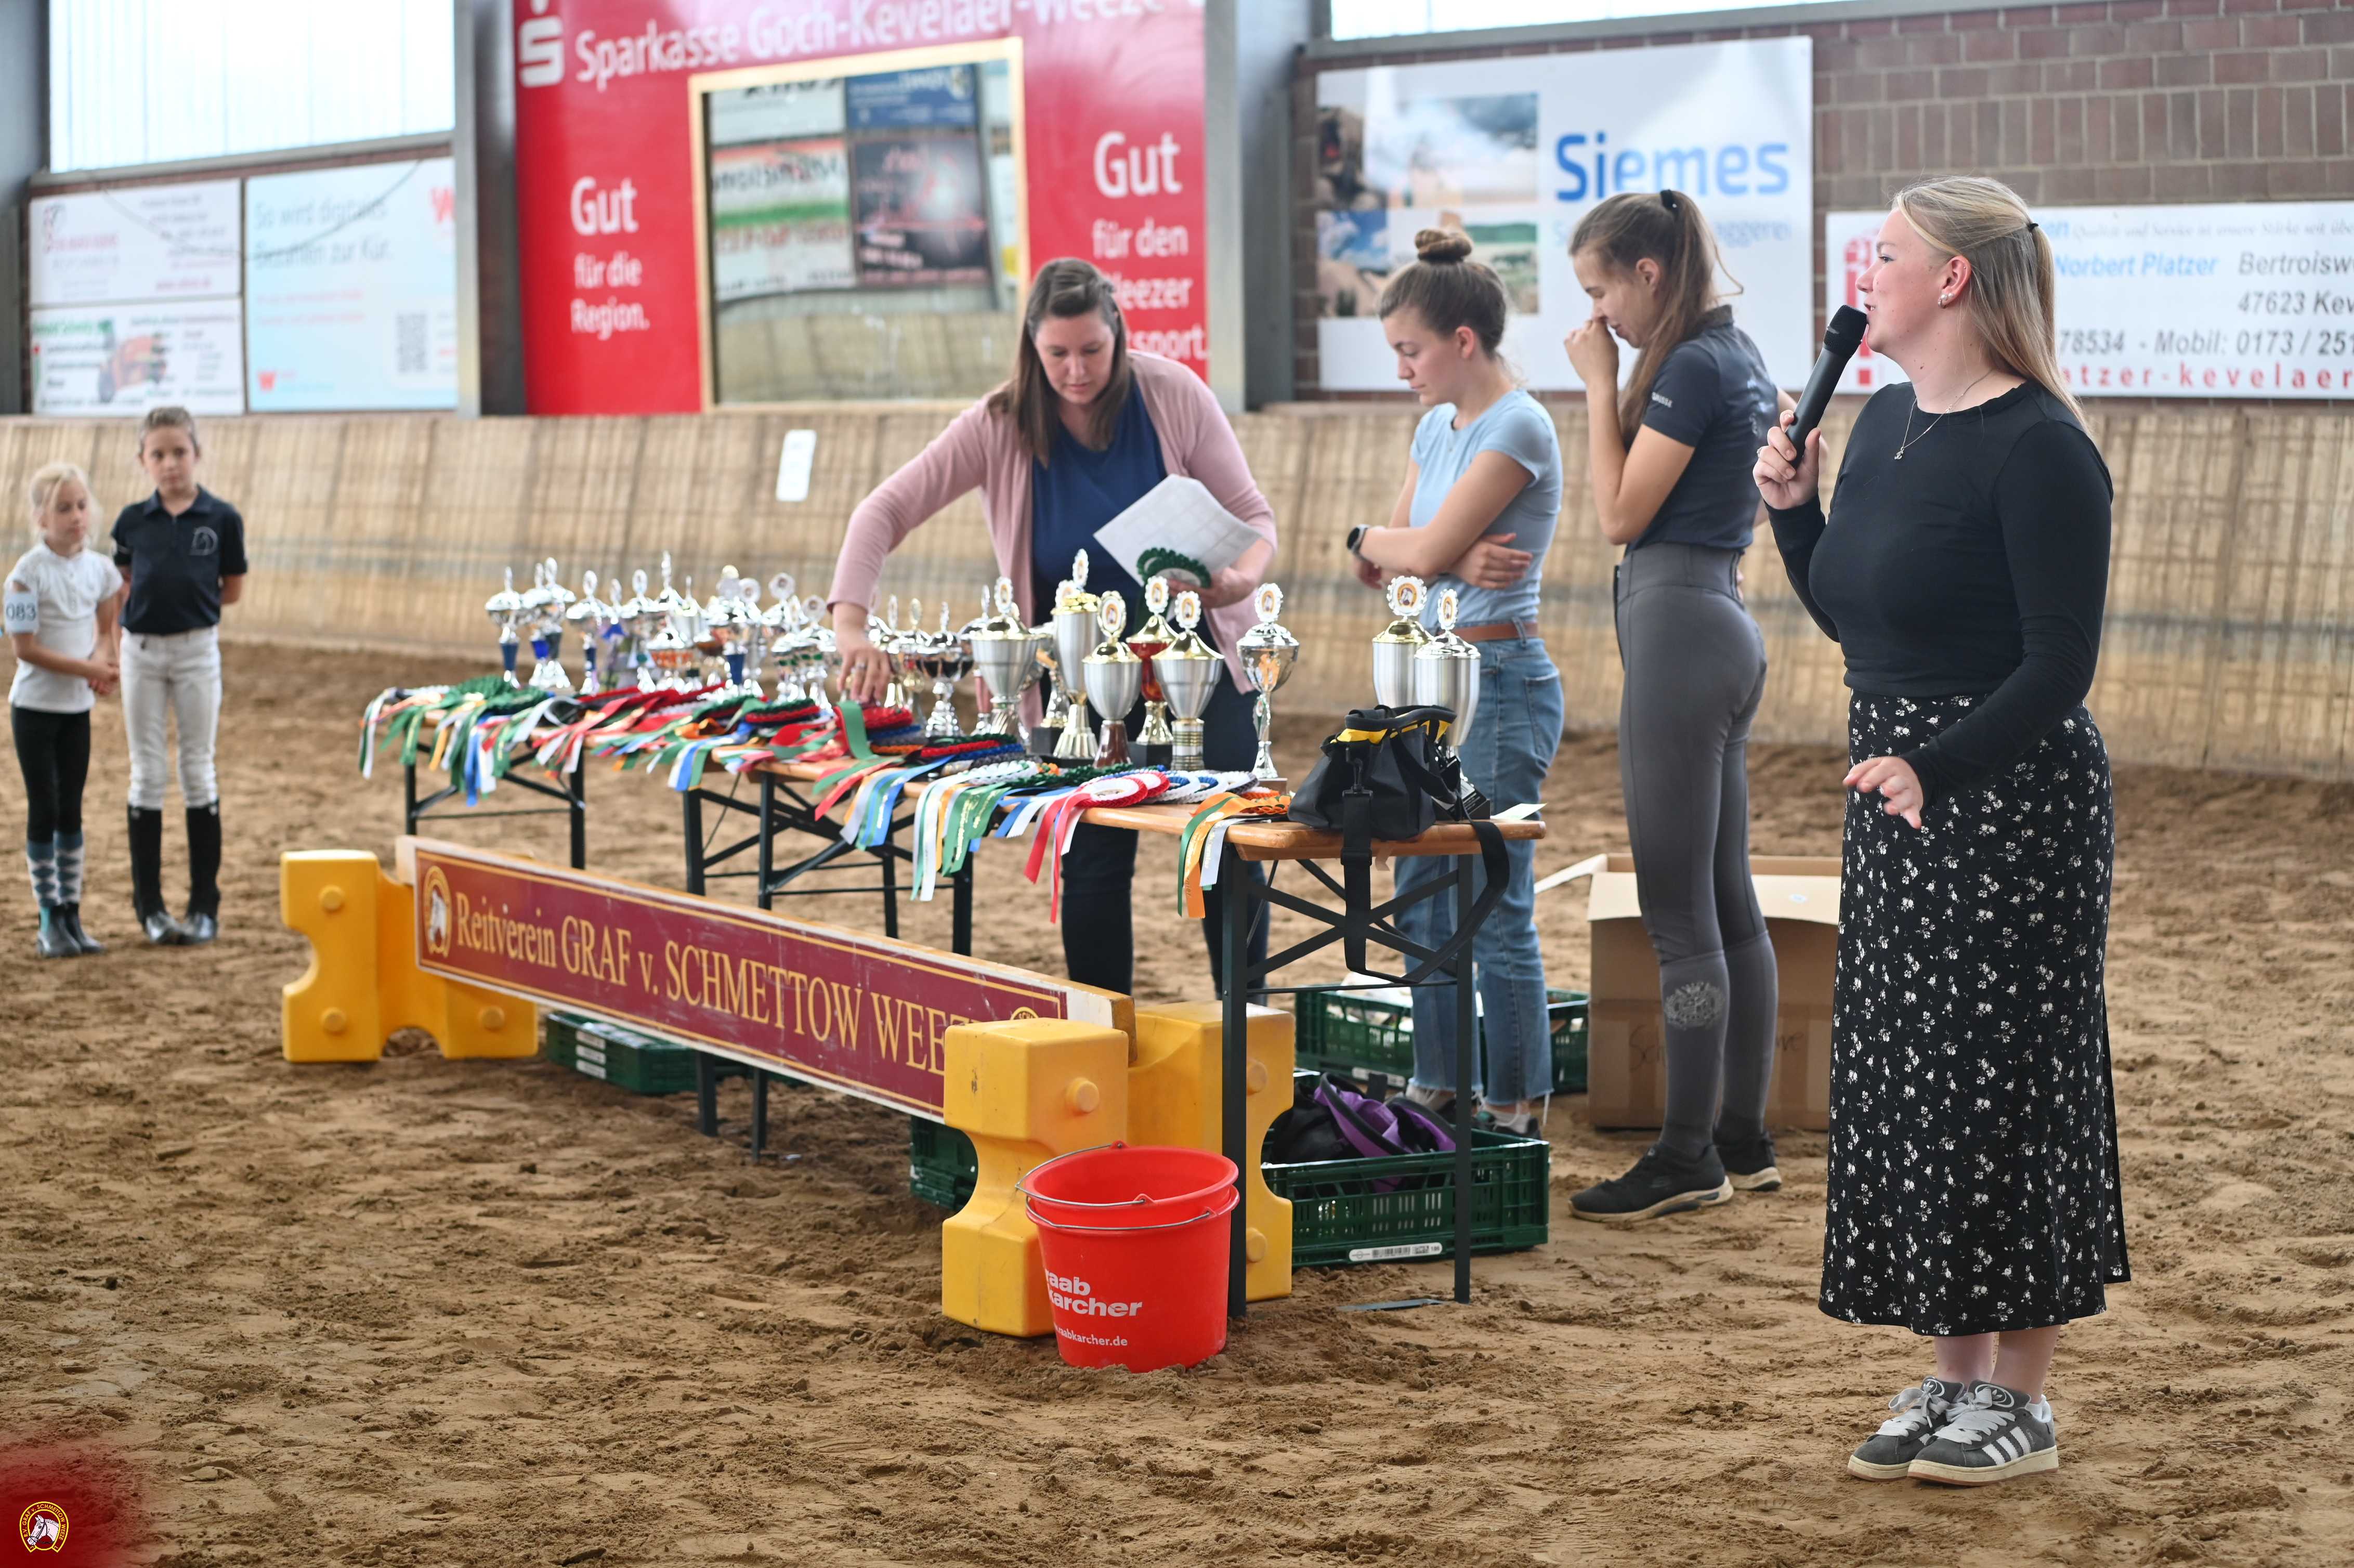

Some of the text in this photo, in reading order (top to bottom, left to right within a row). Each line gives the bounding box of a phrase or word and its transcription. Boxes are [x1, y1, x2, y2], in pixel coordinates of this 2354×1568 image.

[576, 19, 741, 93] Sparkasse
[1093, 131, 1183, 198] Gut
[1554, 130, 1790, 202] Siemes
[571, 176, 638, 236] Gut
[1092, 216, 1188, 258] für den
[2331, 218, 2354, 234] übe
[574, 252, 642, 289] für die
[2055, 251, 2135, 276] Norbert
[2141, 250, 2219, 276] Platzer
[571, 296, 650, 341] Region.
[2238, 289, 2354, 315] 47623 Kev
[2154, 328, 2227, 355] Mobil:
[2236, 328, 2294, 356] 0173
[6, 603, 36, 622] 083
[456, 892, 982, 1076] Reitverein GRAF v. SCHMETTOW WEE
[1045, 1269, 1091, 1296] raab
[1049, 1289, 1143, 1317] karcher
